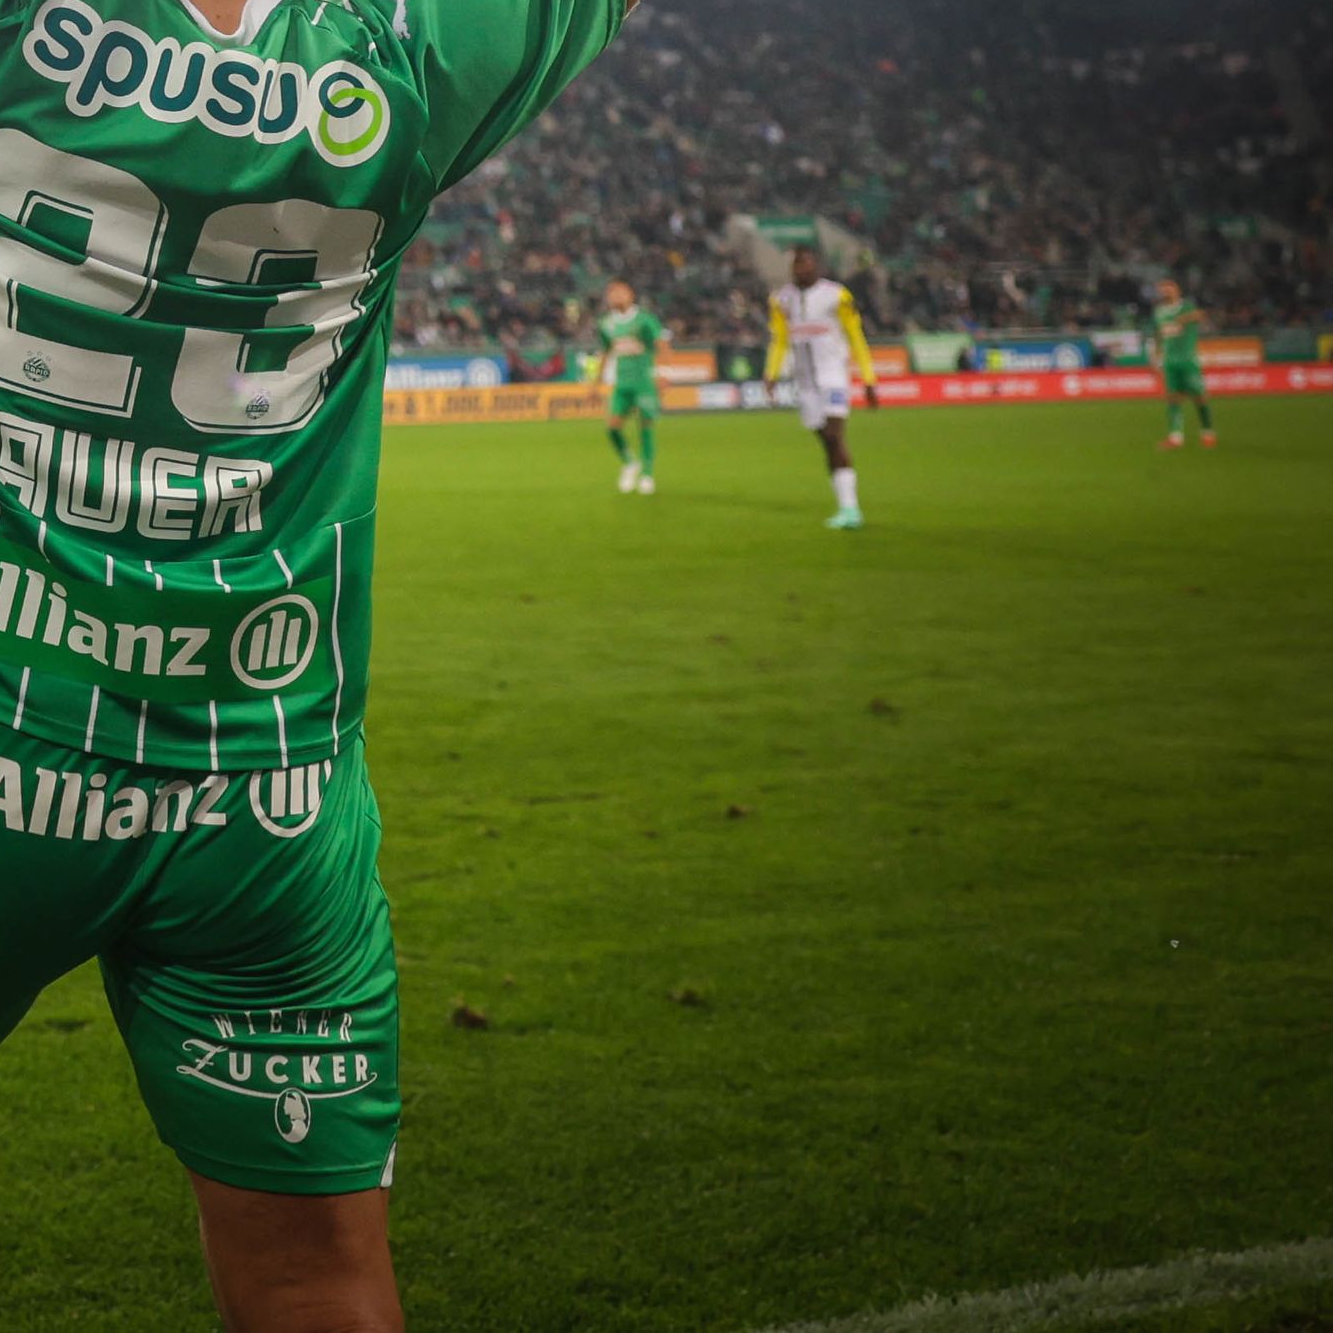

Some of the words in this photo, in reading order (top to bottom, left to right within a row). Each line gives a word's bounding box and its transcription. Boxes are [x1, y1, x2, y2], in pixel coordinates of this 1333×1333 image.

[27, 0, 305, 141] spusu
[211, 1009, 353, 1043] WIENER
[176, 1038, 371, 1086] ZUCKER
